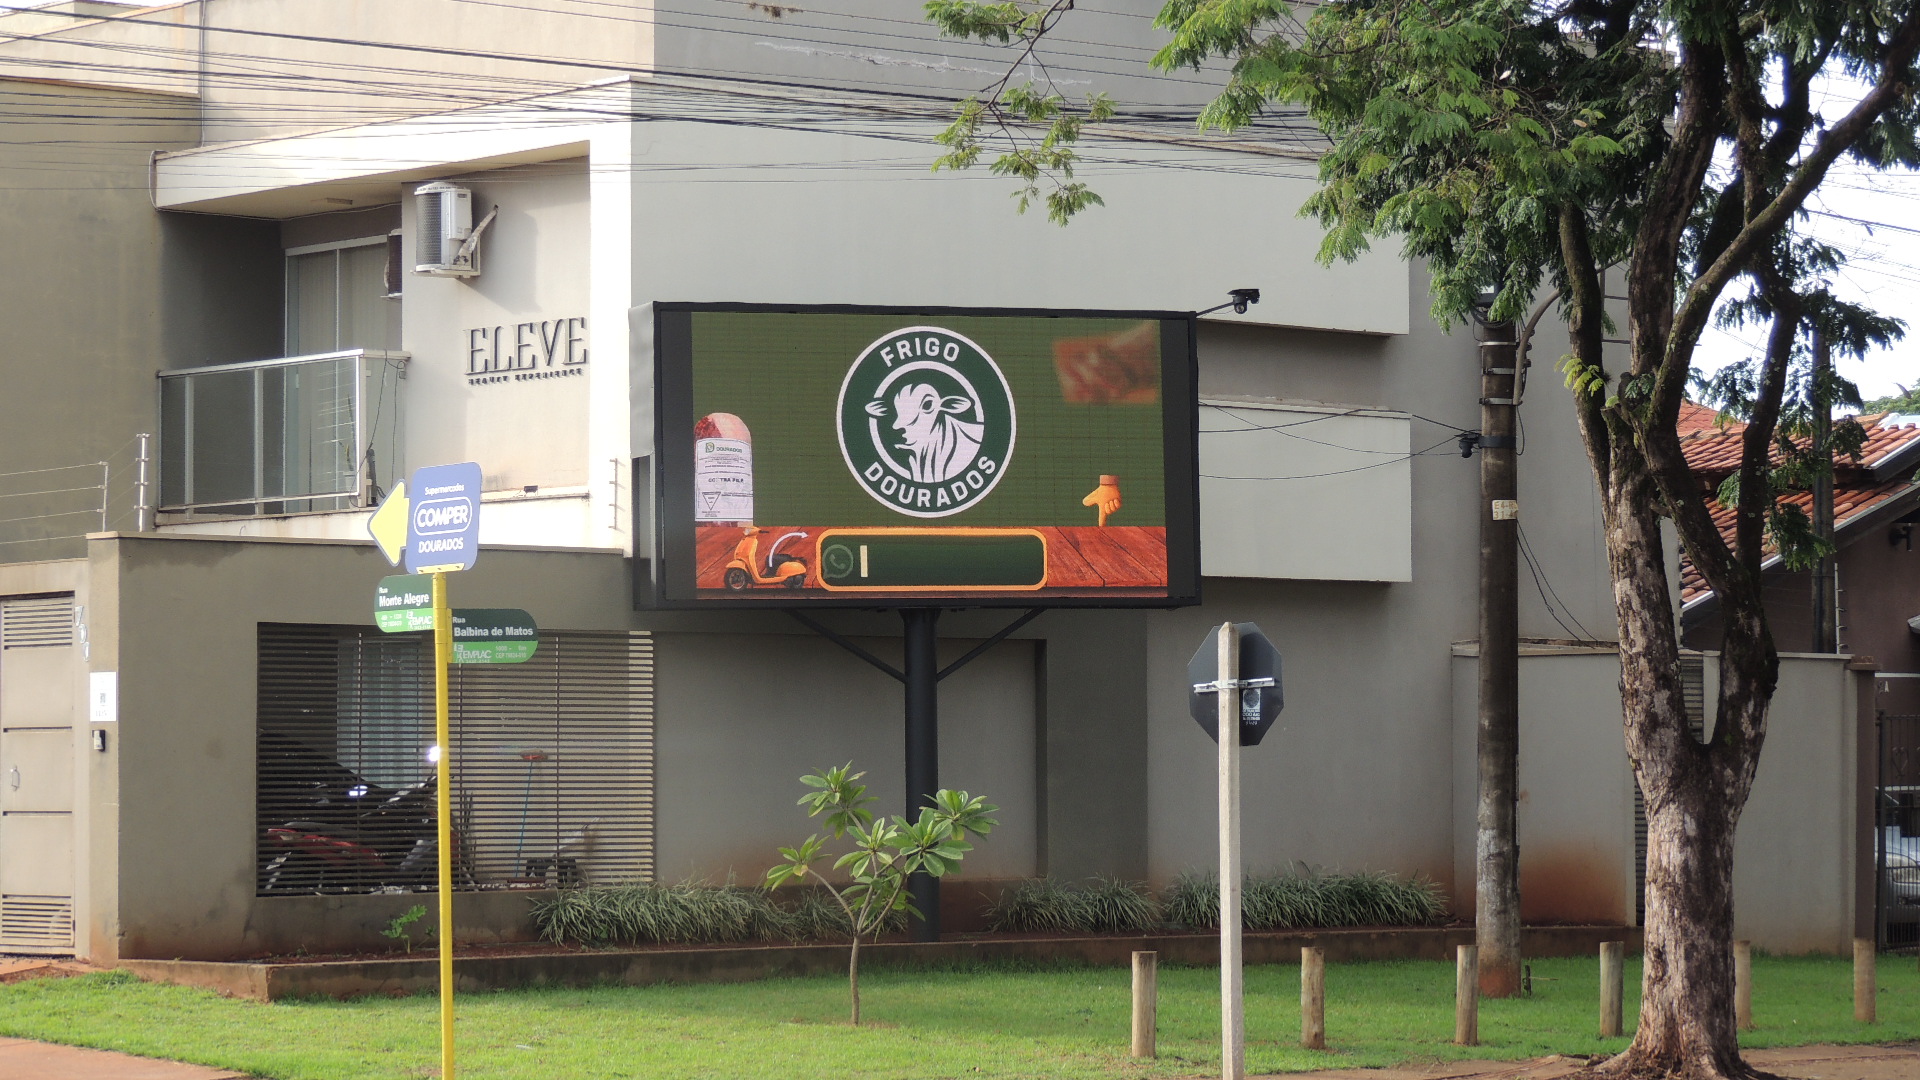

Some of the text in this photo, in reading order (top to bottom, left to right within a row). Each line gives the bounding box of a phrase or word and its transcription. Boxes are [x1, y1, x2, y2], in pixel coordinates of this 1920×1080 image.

[463, 317, 588, 375] ELEVE
[879, 337, 960, 368] FRIGO
[424, 482, 465, 496] Supermercados
[864, 456, 996, 508] DOURADOS
[416, 505, 469, 528] COMPER
[418, 537, 464, 553] DOURADOS
[379, 593, 430, 607] Monte Alegre
[454, 626, 534, 637] Balbina de Matos
